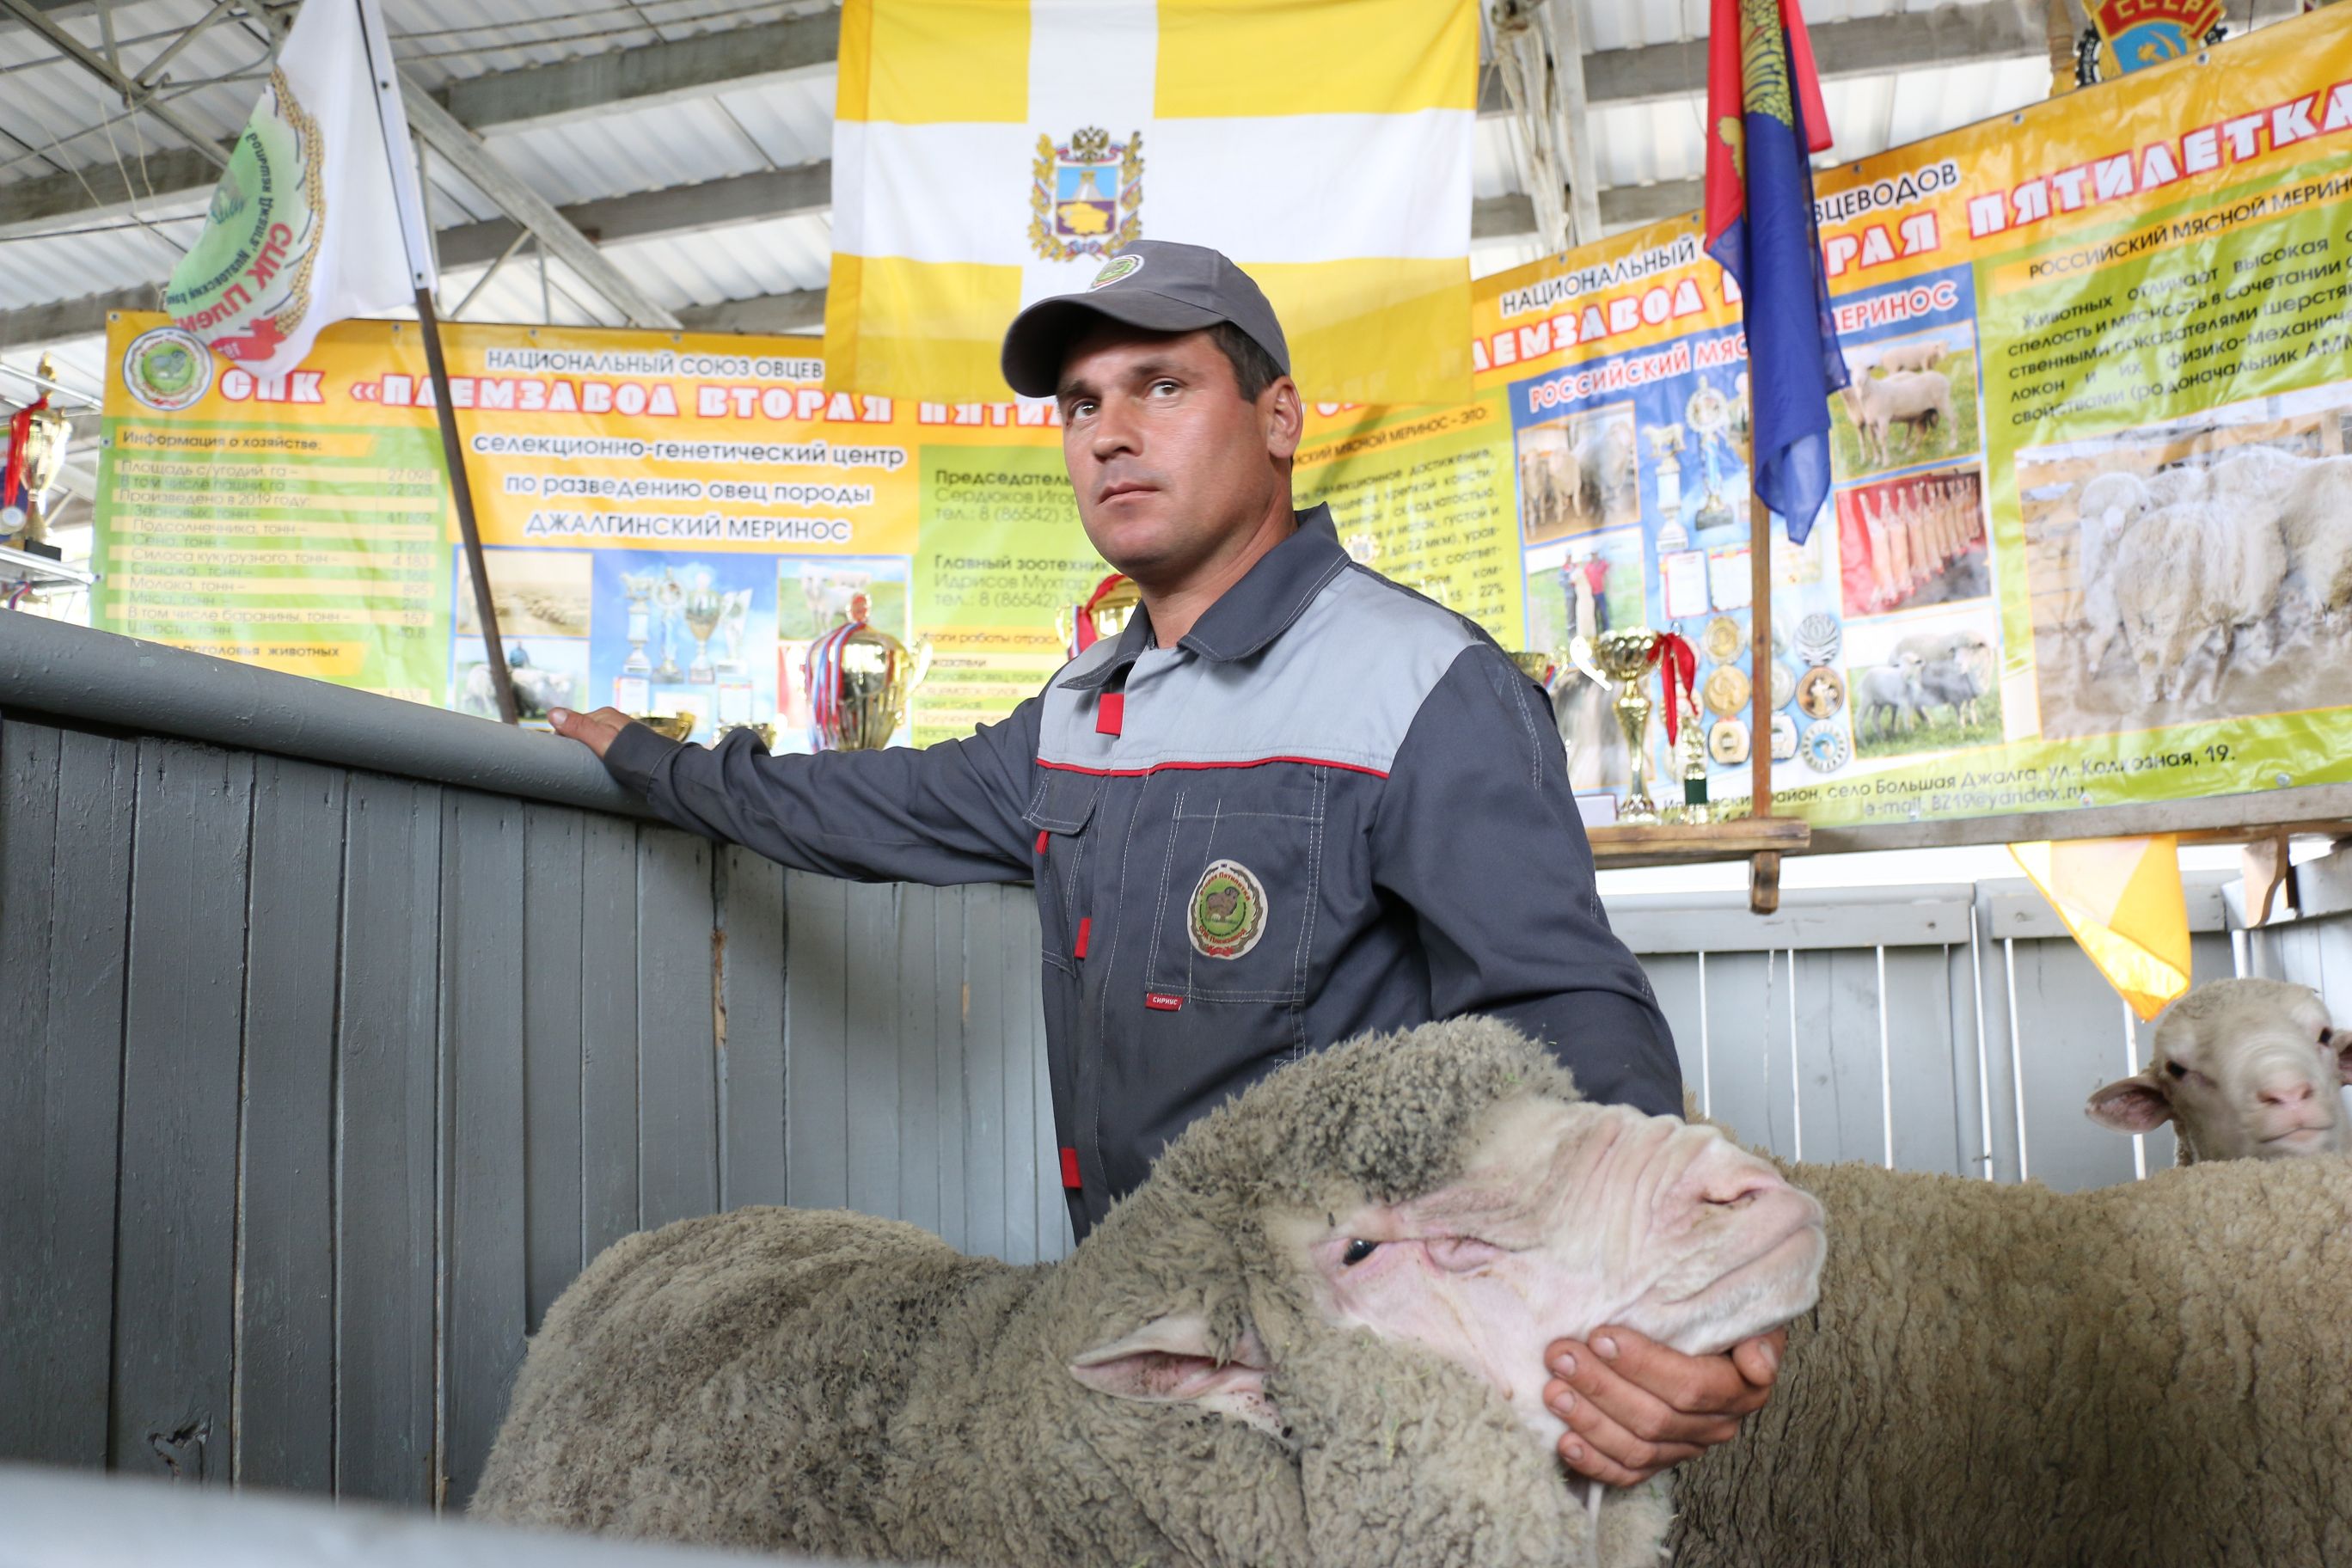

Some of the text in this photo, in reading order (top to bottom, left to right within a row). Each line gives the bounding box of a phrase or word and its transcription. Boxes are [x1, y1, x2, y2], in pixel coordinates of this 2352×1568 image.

[1966, 79, 2352, 241] ПЯТИЛЕТКА
[1814, 162, 1958, 224] ВЦЕВОДОВ
[1823, 209, 1941, 279] РАЯ
[2029, 224, 2168, 279] РОССИЙСКИЙ
[2172, 198, 2268, 240] МЯСНОЙ
[1502, 237, 1695, 315] НАЦИОНАЛЬНЫЙ
[2022, 237, 2331, 331] Животных отличает высокая
[2008, 323, 2092, 357] спелость
[2096, 319, 2108, 334] и
[2111, 297, 2208, 330] мясность
[2211, 291, 2221, 305] в
[2225, 260, 2342, 301] сочетании
[1472, 277, 1709, 373] ЛЕМЗАВОД
[2009, 344, 2110, 381] ственными
[2113, 306, 2258, 354] показателями
[487, 350, 824, 381] НАЦИОНАЛЬНЫЙ СОЮЗ ОВЦЕВ
[1530, 334, 1750, 413] РОССИЙСКИЙ МЯС
[2010, 378, 2065, 403] локон
[2085, 371, 2097, 385] и
[2118, 358, 2143, 377] их
[2012, 389, 2126, 427] свойствами
[2130, 348, 2299, 403] (родоначальник
[219, 368, 326, 404] СПК
[695, 384, 895, 423] ВТОРАЯ
[1389, 417, 1449, 444] МЕРИНОС
[122, 430, 322, 453] Информация о хозяйстве:
[474, 433, 905, 469] селекционно-генетический центр
[121, 459, 193, 477] Площадь
[270, 466, 286, 477] га
[134, 477, 162, 489] том
[164, 478, 211, 490] числе
[269, 481, 286, 493] га
[505, 475, 872, 505] по разведению овец породы
[119, 489, 224, 507] Произведено
[227, 495, 235, 505] в
[934, 487, 1077, 505] Сердюков Игор
[217, 508, 249, 519] тонн
[979, 507, 989, 521] 8
[994, 507, 1059, 524] (86542)
[263, 524, 296, 535] тонн
[525, 513, 850, 541] ДЖАЛГИНСКИЙ МЕРИНОС
[183, 536, 216, 548] тонн
[131, 548, 193, 562] Силоса
[295, 554, 328, 565] тонн
[934, 554, 1012, 570] Главный
[208, 567, 242, 578] тонн
[934, 573, 1018, 590] Идрисов
[1022, 573, 1091, 591] Мухтар
[200, 580, 235, 591] тонн
[181, 595, 216, 606] тонн
[979, 592, 989, 607] 8
[128, 605, 138, 618] В
[142, 609, 168, 620] том
[173, 609, 219, 621] числе
[307, 613, 340, 623] тонн
[198, 625, 232, 635] тонн
[959, 633, 1010, 646] работы
[1014, 633, 1061, 646] отрасл
[267, 646, 340, 658] животных
[1827, 784, 1871, 800] село
[1875, 775, 1957, 796] Большая
[1960, 766, 2043, 790] Джалга,
[2049, 763, 2077, 783] ул.
[2205, 744, 2237, 763] 19.
[1152, 995, 1179, 1006] СИРИУС
